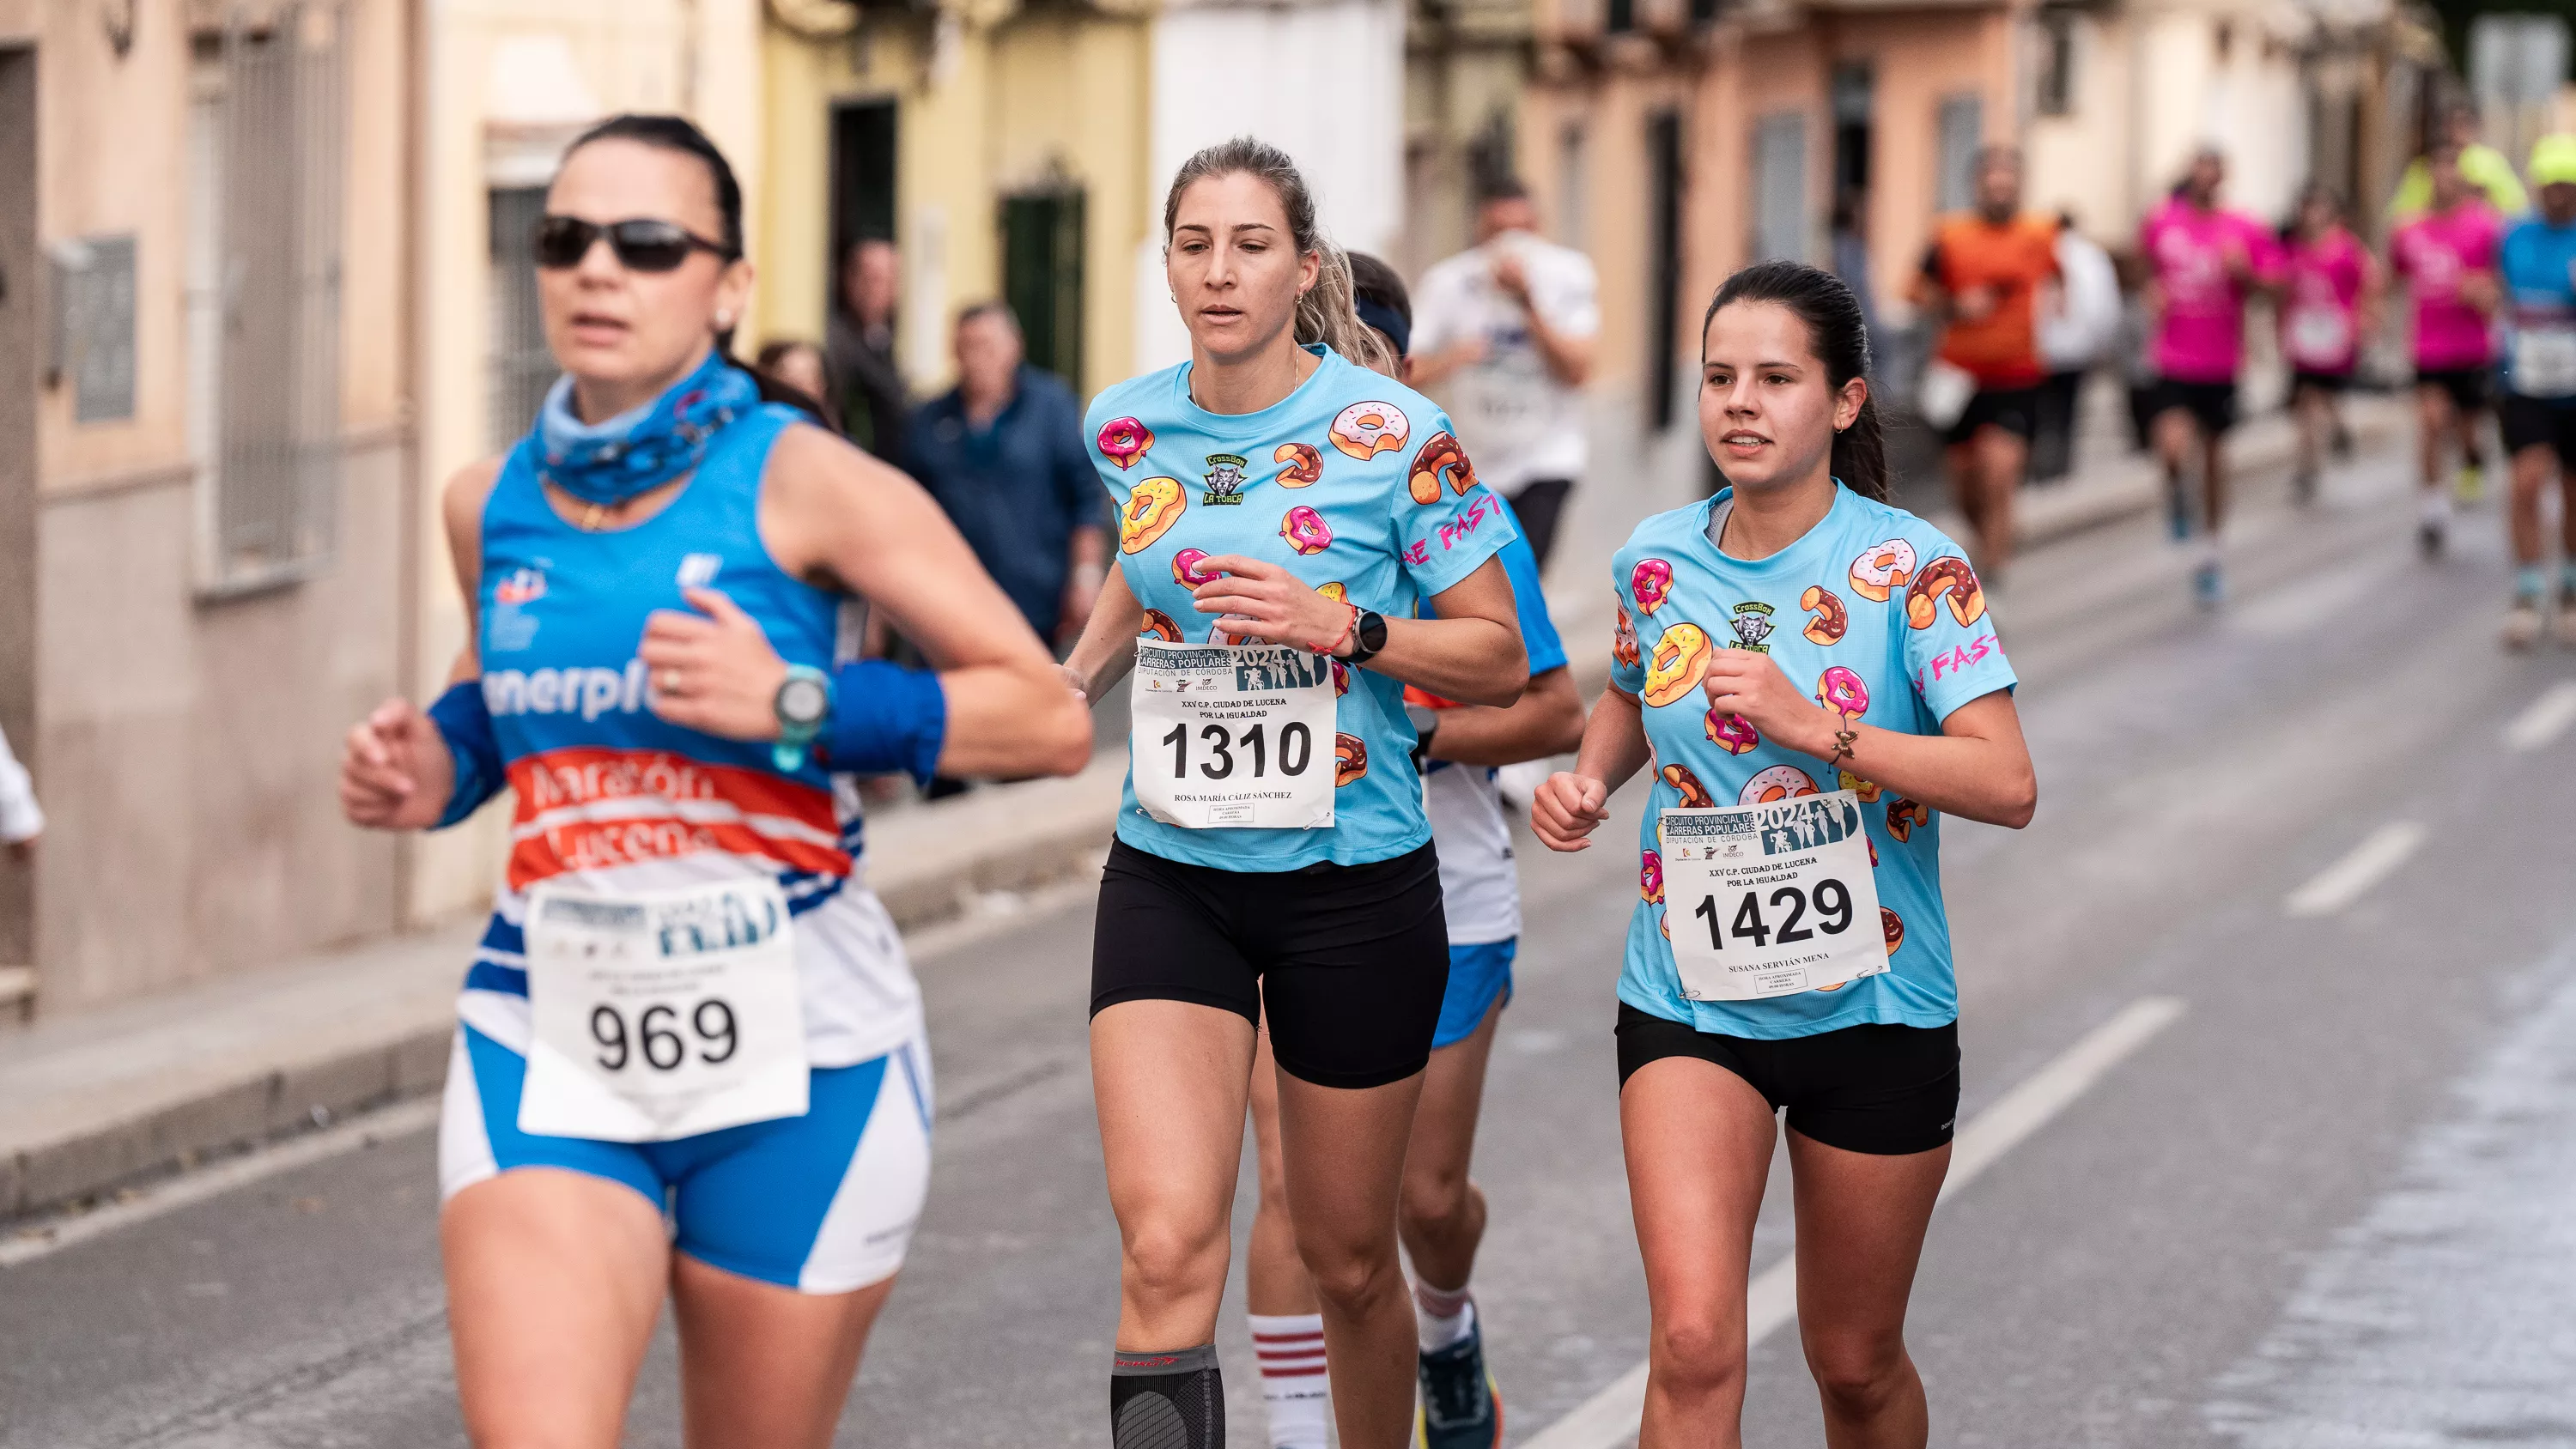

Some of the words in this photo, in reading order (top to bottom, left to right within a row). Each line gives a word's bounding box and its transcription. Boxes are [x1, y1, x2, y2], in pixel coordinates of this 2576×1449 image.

[1207, 456, 1245, 467] CrossBox
[1204, 494, 1214, 504] LA
[1216, 494, 1242, 504] TORCA
[1438, 494, 1501, 551] FAST
[1735, 603, 1772, 615] CrossBox
[1139, 646, 1166, 658] CIRCUITO
[1168, 650, 1218, 659] PROVINCIAL
[1230, 649, 1285, 667] 2024
[1139, 657, 1176, 668] CARRERAS
[1179, 658, 1231, 668] POPULARES
[1138, 667, 1176, 676] DIPUTACIÓN
[1195, 667, 1233, 676] CÓRDOBA
[1255, 698, 1287, 706] LUCENA
[1226, 710, 1267, 718] IGUALDAD
[1163, 721, 1311, 779] 1310
[1200, 792, 1226, 802] MARÍA
[1228, 791, 1251, 801] CÁLIZ
[1253, 791, 1292, 799] SÁNCHEZ
[1666, 816, 1693, 826] CIRCUITO
[1695, 815, 1741, 826] PROVINCIAL
[1743, 813, 1754, 822] DE
[1757, 803, 1814, 831] 2024
[1666, 825, 1703, 836] CARRERAS
[1705, 822, 1757, 834] POPULARES
[1666, 835, 1704, 844] DIPUTACIÓN
[1721, 833, 1759, 842] CÓRDOBA
[1710, 868, 1725, 876] XXV
[1741, 865, 1771, 875] CIUDAD
[1784, 857, 1818, 869] LUCENA
[1756, 871, 1798, 884] IGUALDAD
[1695, 878, 1853, 950] 1429
[1728, 963, 1761, 973] SUSANA
[1762, 956, 1801, 970] SERVIÁN
[1802, 952, 1830, 963] MENA
[591, 998, 738, 1071] 969
